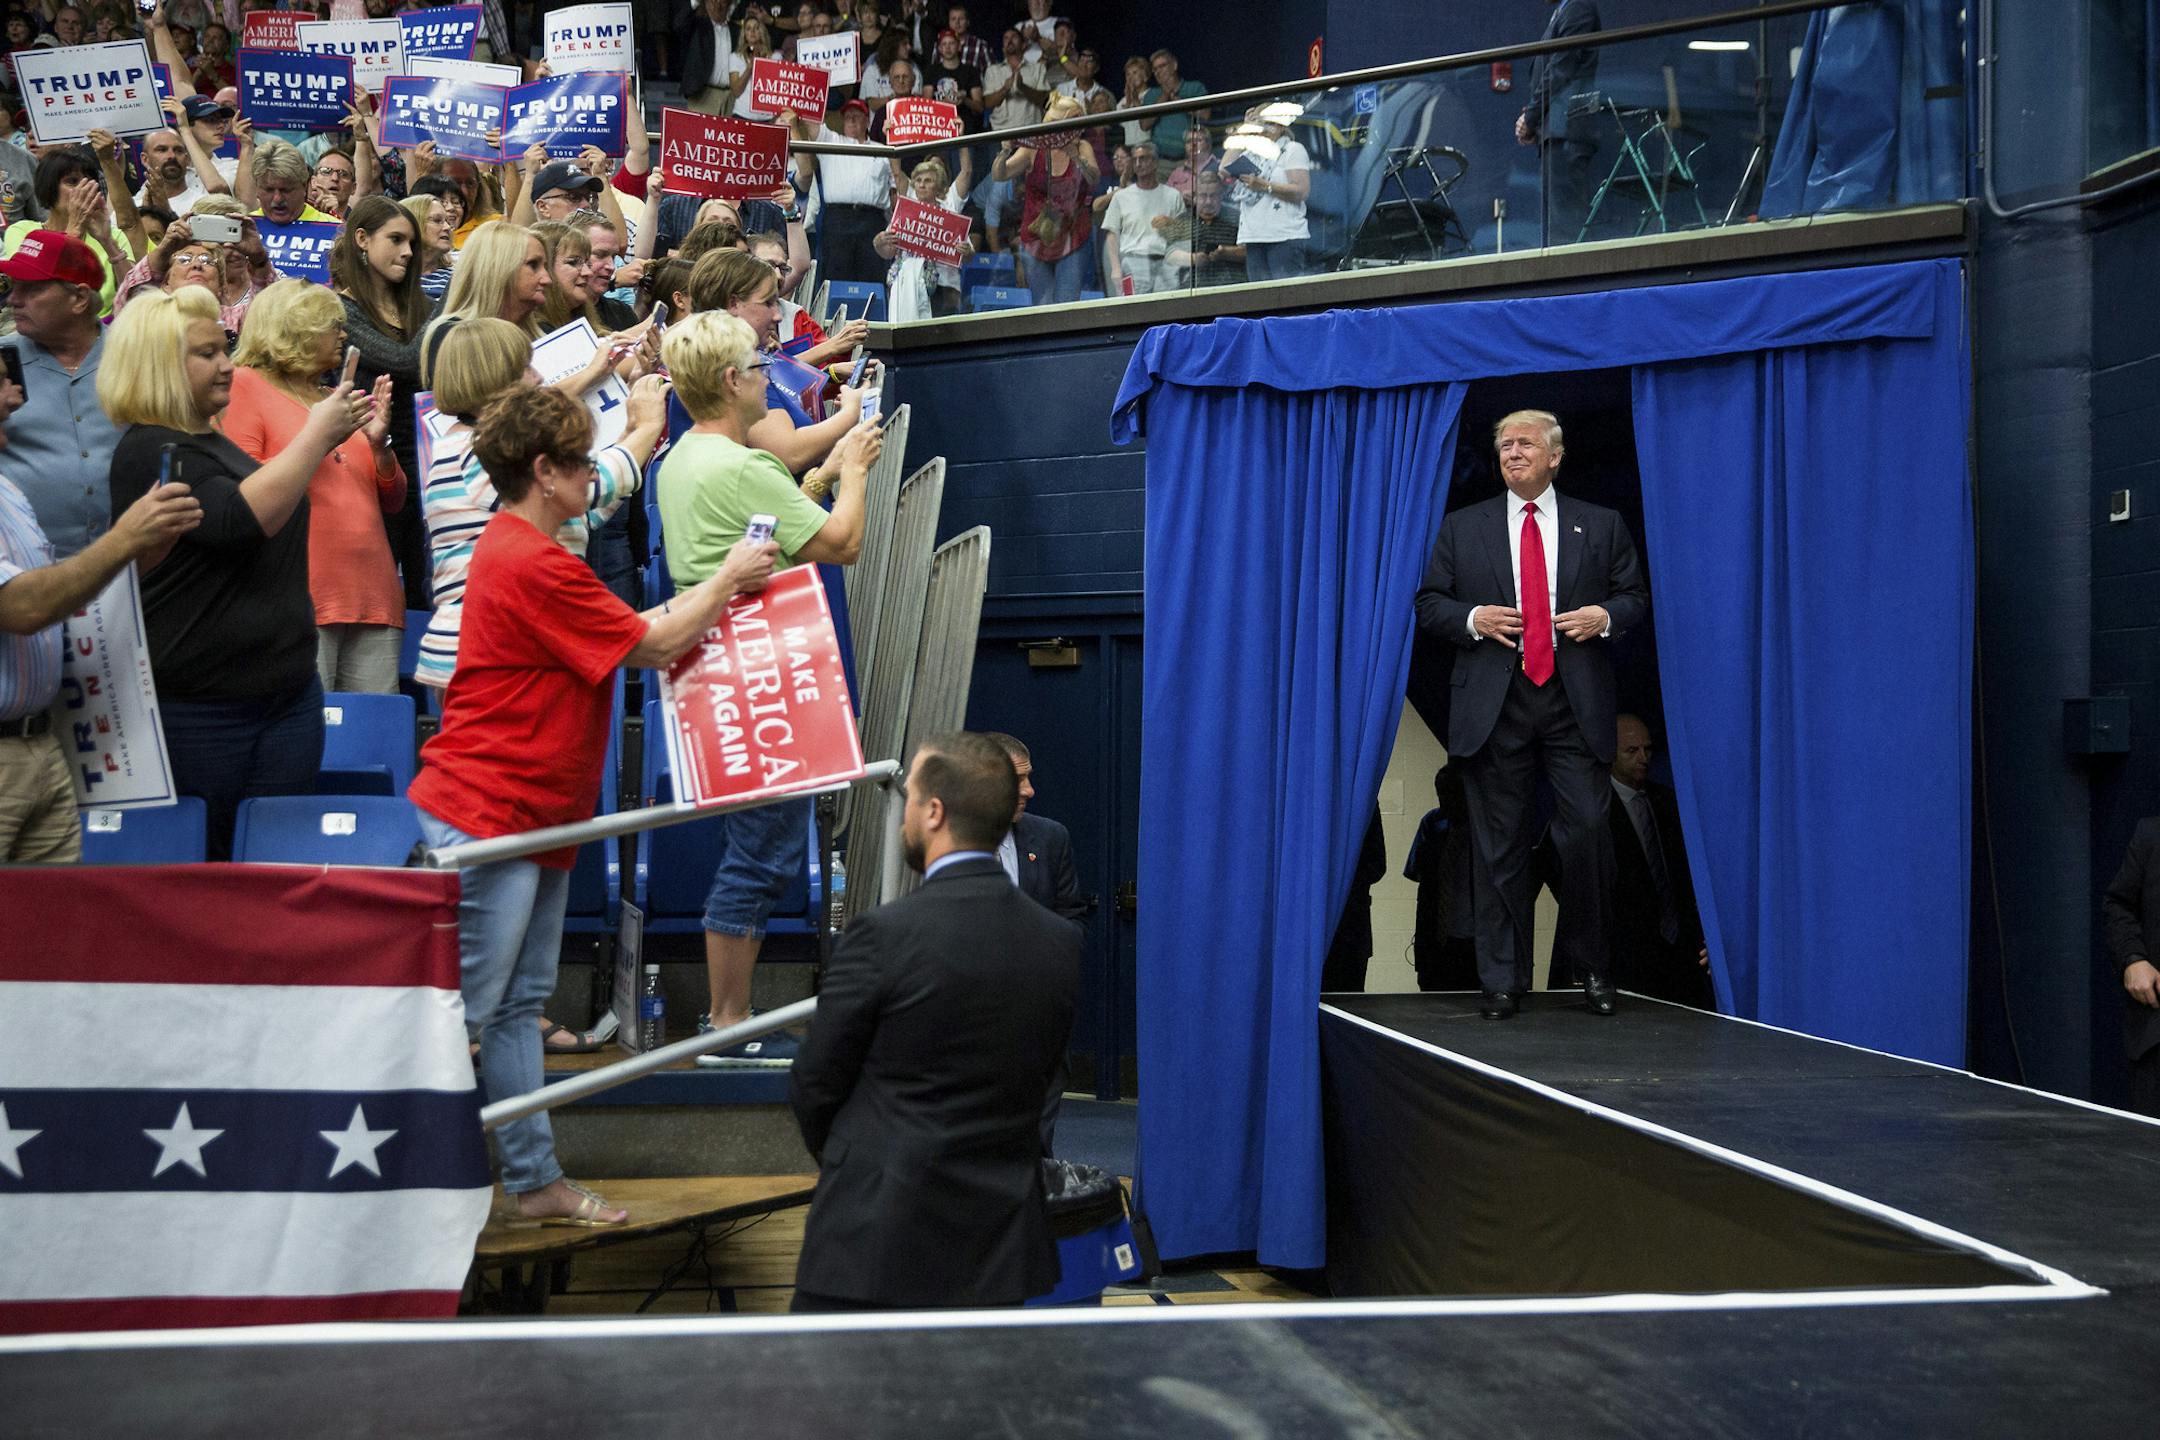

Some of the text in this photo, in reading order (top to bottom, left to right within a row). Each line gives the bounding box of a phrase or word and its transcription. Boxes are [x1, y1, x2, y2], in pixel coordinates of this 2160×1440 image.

[268, 17, 292, 25] MAKE
[402, 21, 475, 39] TRUMP
[247, 26, 298, 38] AMERI
[550, 24, 627, 42] TRUMP
[250, 38, 298, 48] GREAT AGA
[306, 40, 397, 55] TRUMP
[554, 39, 621, 52] PENCE
[802, 47, 851, 61] TRUMP
[29, 67, 144, 94] TRUMP
[244, 70, 347, 90] TRUMP
[778, 69, 806, 82] MAKE
[44, 88, 137, 107] PENCE
[254, 88, 337, 102] PENCE
[754, 78, 825, 102] AMERICA
[44, 109, 62, 117] MAKE
[64, 107, 92, 116] AMERICA
[94, 105, 117, 113] GREAT
[392, 94, 500, 120] TRUMP
[510, 95, 618, 118] TRUMP
[758, 93, 820, 112] GREAT AGAIN
[910, 104, 934, 114] MAKE
[400, 109, 488, 131] PENCE
[518, 113, 607, 128] PENCE
[890, 113, 956, 130] AMERICA
[415, 123, 444, 133] AMERICA
[445, 128, 466, 136] GREAT
[534, 126, 563, 134] AMERICA
[704, 127, 745, 146] MAKE
[893, 125, 953, 138] GREAT AGAIN
[665, 139, 783, 171] AMERICA
[672, 163, 774, 185] GREAT AGAIN
[919, 210, 945, 226] MAKE
[893, 216, 962, 245] AMERICA
[259, 233, 335, 252] UMP
[925, 240, 957, 256] AGAIN
[268, 249, 322, 262] NCE
[98, 639, 112, 678] GREAT
[782, 626, 820, 704] MAKE
[73, 609, 119, 772] PENC
[727, 594, 800, 786] MERICA
[62, 622, 104, 793] TRUM
[107, 681, 124, 738] AMERICA
[700, 625, 751, 777] EAT AGAIN
[119, 742, 134, 777] MAKE
[101, 815, 109, 827] 3
